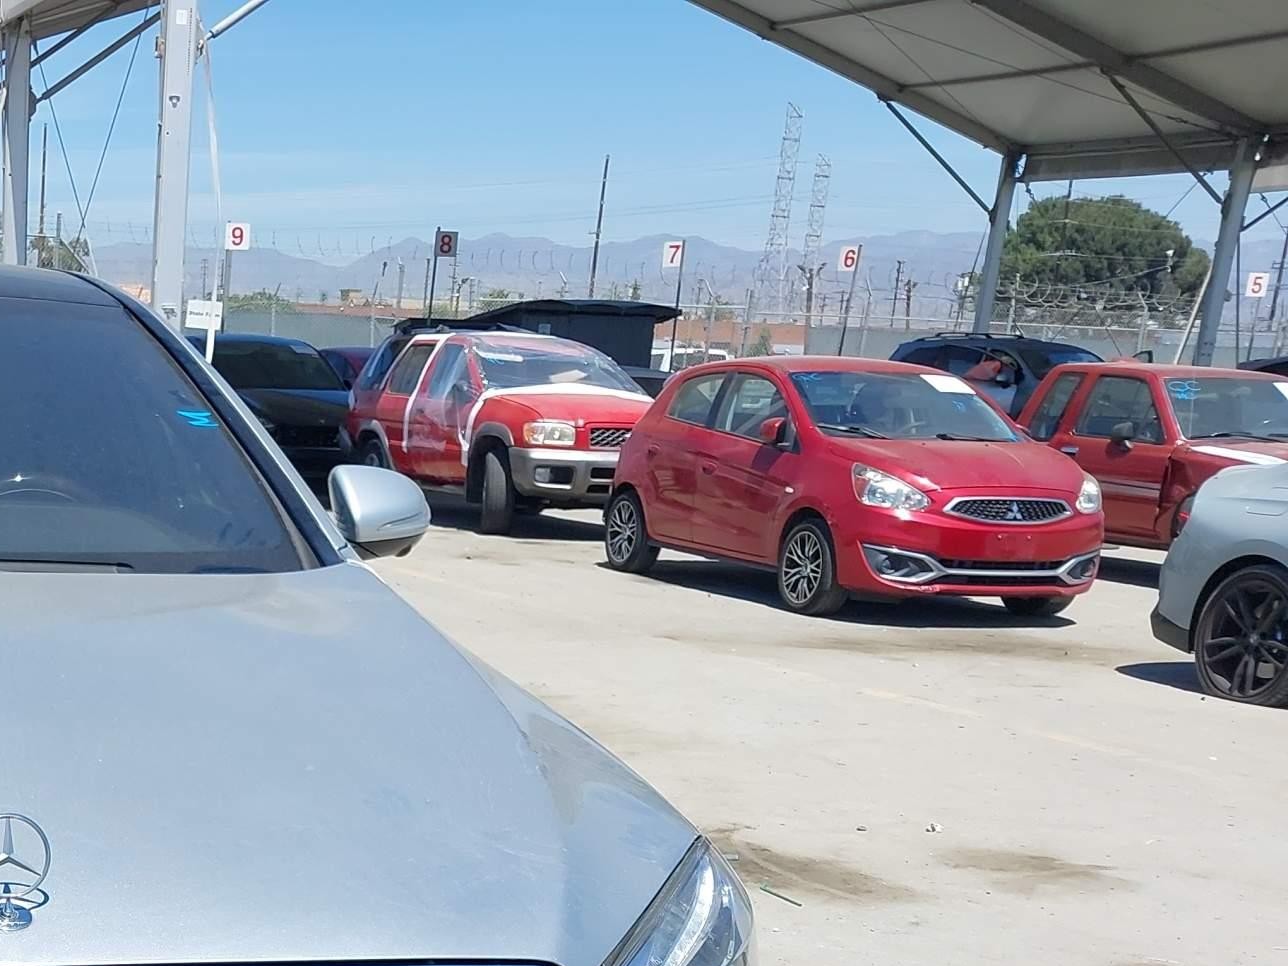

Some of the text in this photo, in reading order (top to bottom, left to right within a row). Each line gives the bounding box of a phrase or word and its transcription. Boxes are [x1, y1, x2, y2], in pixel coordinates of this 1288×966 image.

[231, 226, 244, 246] 9
[439, 234, 452, 254] 8
[669, 244, 681, 264] 7
[844, 249, 857, 268] 6
[1251, 276, 1263, 294] 5
